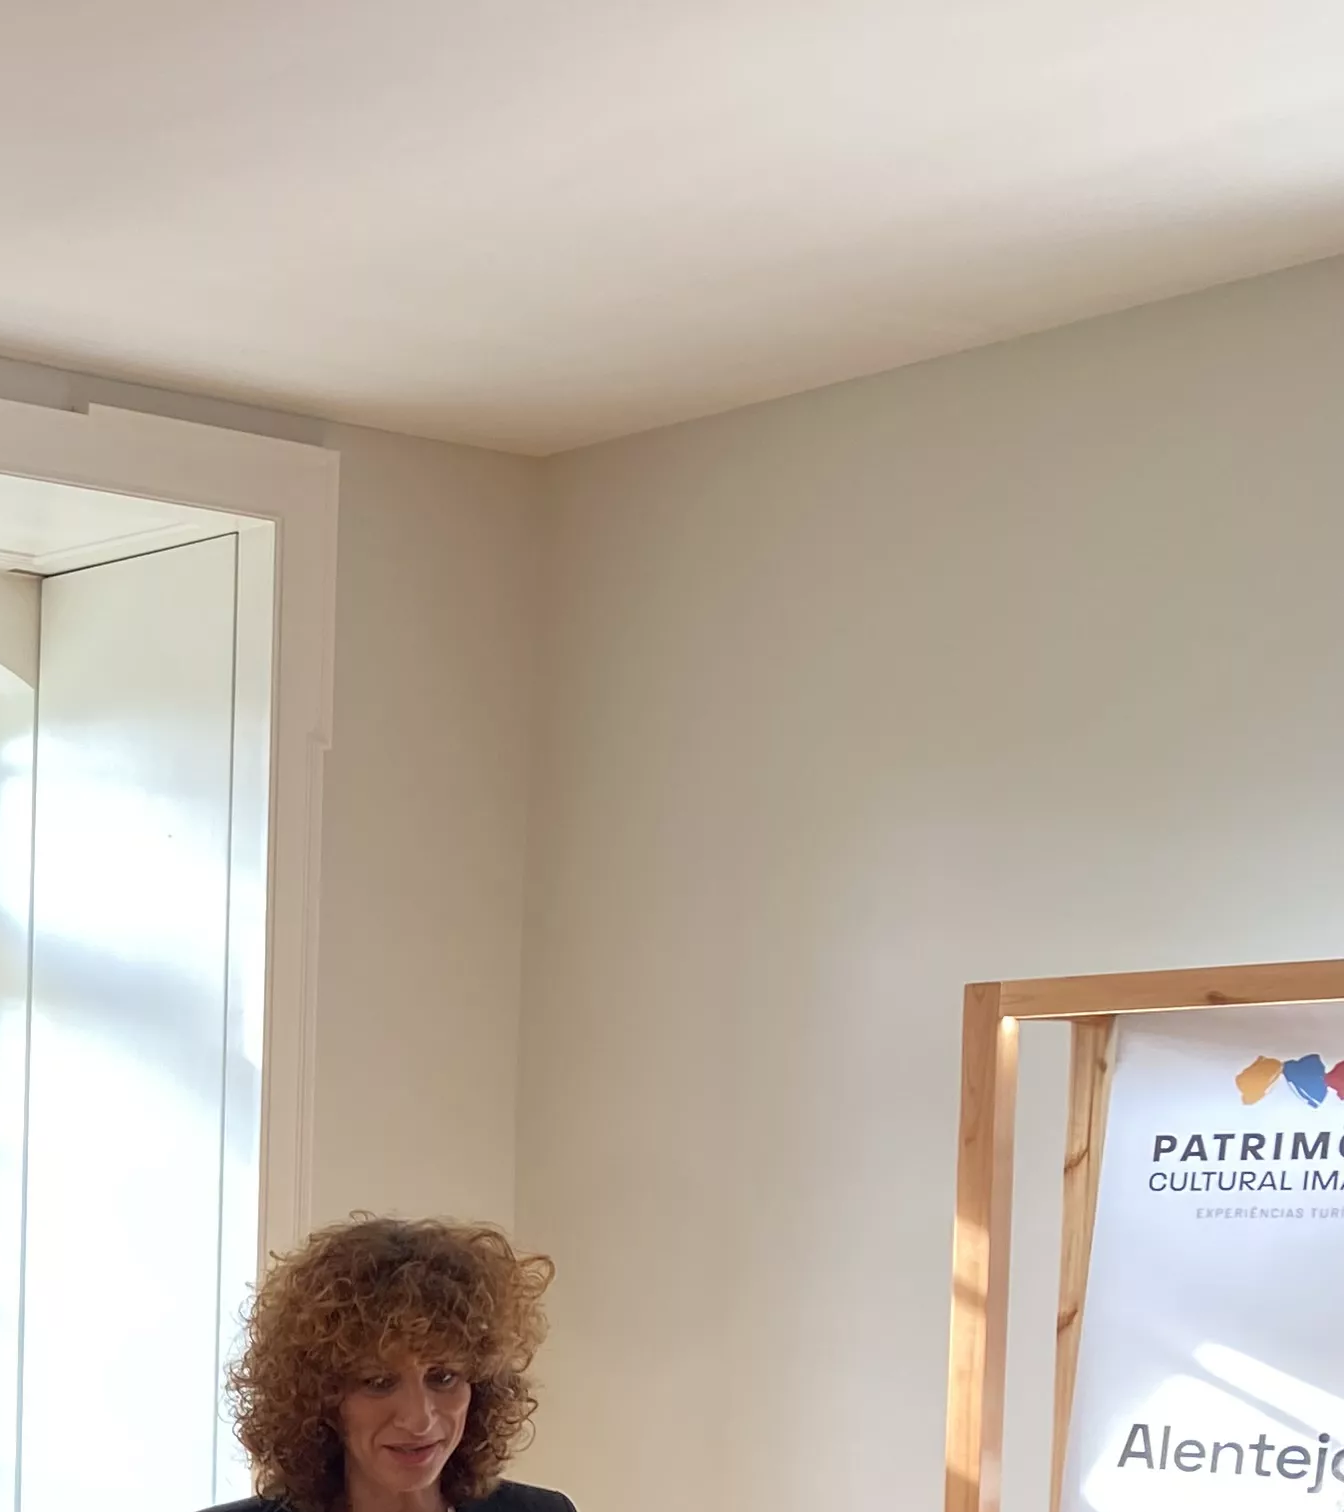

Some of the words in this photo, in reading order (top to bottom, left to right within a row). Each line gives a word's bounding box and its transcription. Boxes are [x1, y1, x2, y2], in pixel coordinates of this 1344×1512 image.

[1152, 1128, 1344, 1162] PATRIM
[1148, 1170, 1293, 1192] CULTURAL
[1301, 1170, 1344, 1191] IM
[1195, 1205, 1305, 1219] EXPERIÊNCIAS
